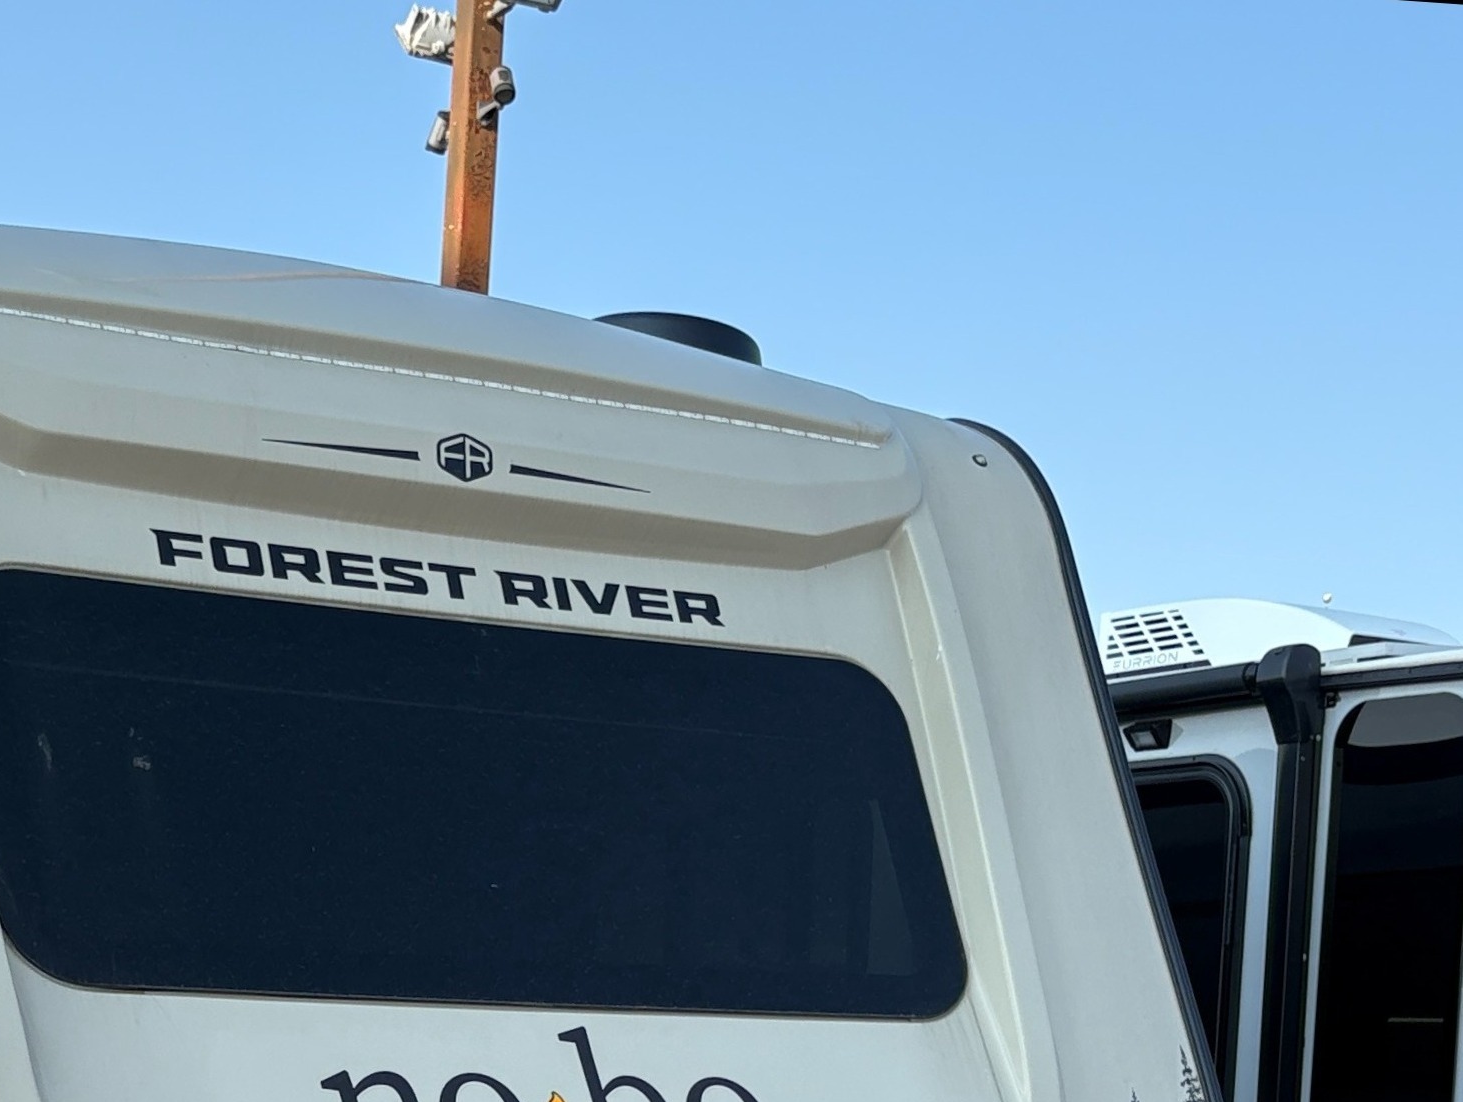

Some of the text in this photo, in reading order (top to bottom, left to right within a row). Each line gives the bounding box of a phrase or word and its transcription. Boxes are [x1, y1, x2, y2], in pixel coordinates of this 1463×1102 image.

[437, 434, 492, 481] FR
[148, 528, 726, 627] FOREST RIVER
[1112, 651, 1179, 671] FURRION
